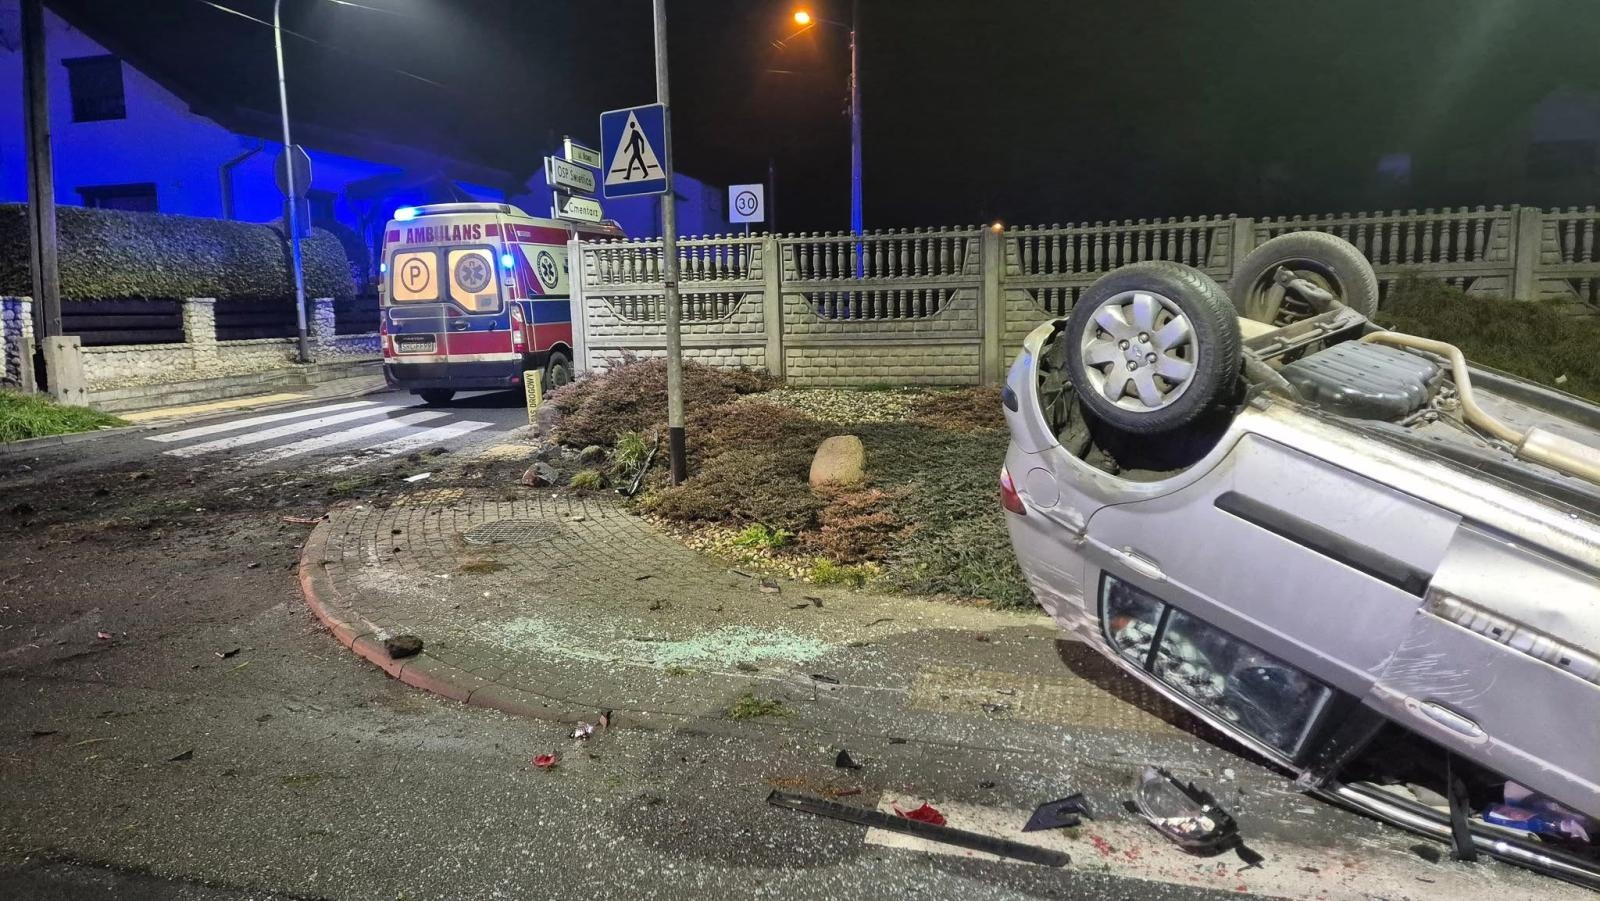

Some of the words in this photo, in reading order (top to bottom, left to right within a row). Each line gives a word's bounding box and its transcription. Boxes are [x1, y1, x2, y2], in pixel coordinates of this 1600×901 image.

[557, 166, 569, 179] OSP
[738, 197, 755, 210] 30
[406, 224, 482, 244] AMBULANS
[410, 265, 421, 286] P
[526, 373, 536, 408] DROGOWY
